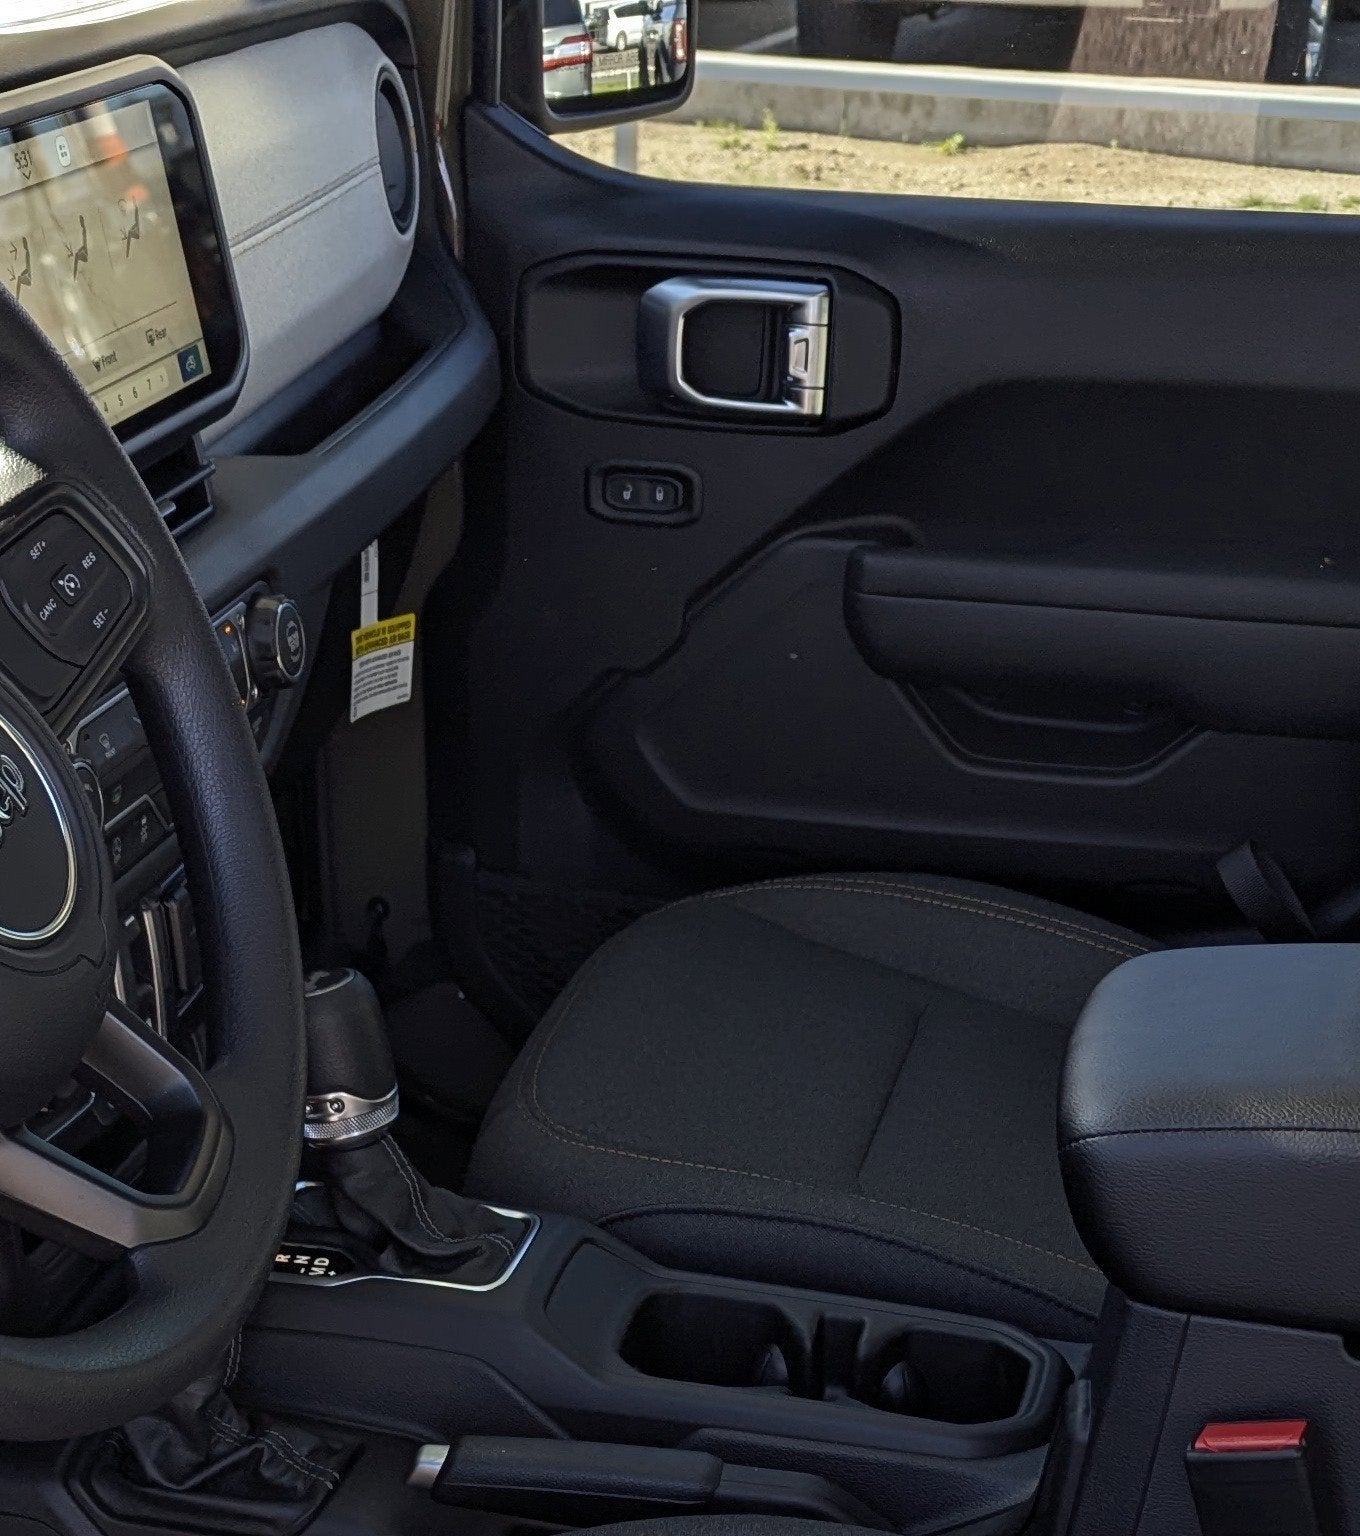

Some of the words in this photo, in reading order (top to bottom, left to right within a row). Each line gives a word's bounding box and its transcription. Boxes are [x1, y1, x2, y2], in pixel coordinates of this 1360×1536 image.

[15, 150, 33, 170] 5:31
[82, 552, 96, 569] RES
[40, 598, 57, 621] CANC
[275, 1253, 291, 1263] R
[314, 1257, 330, 1267] D
